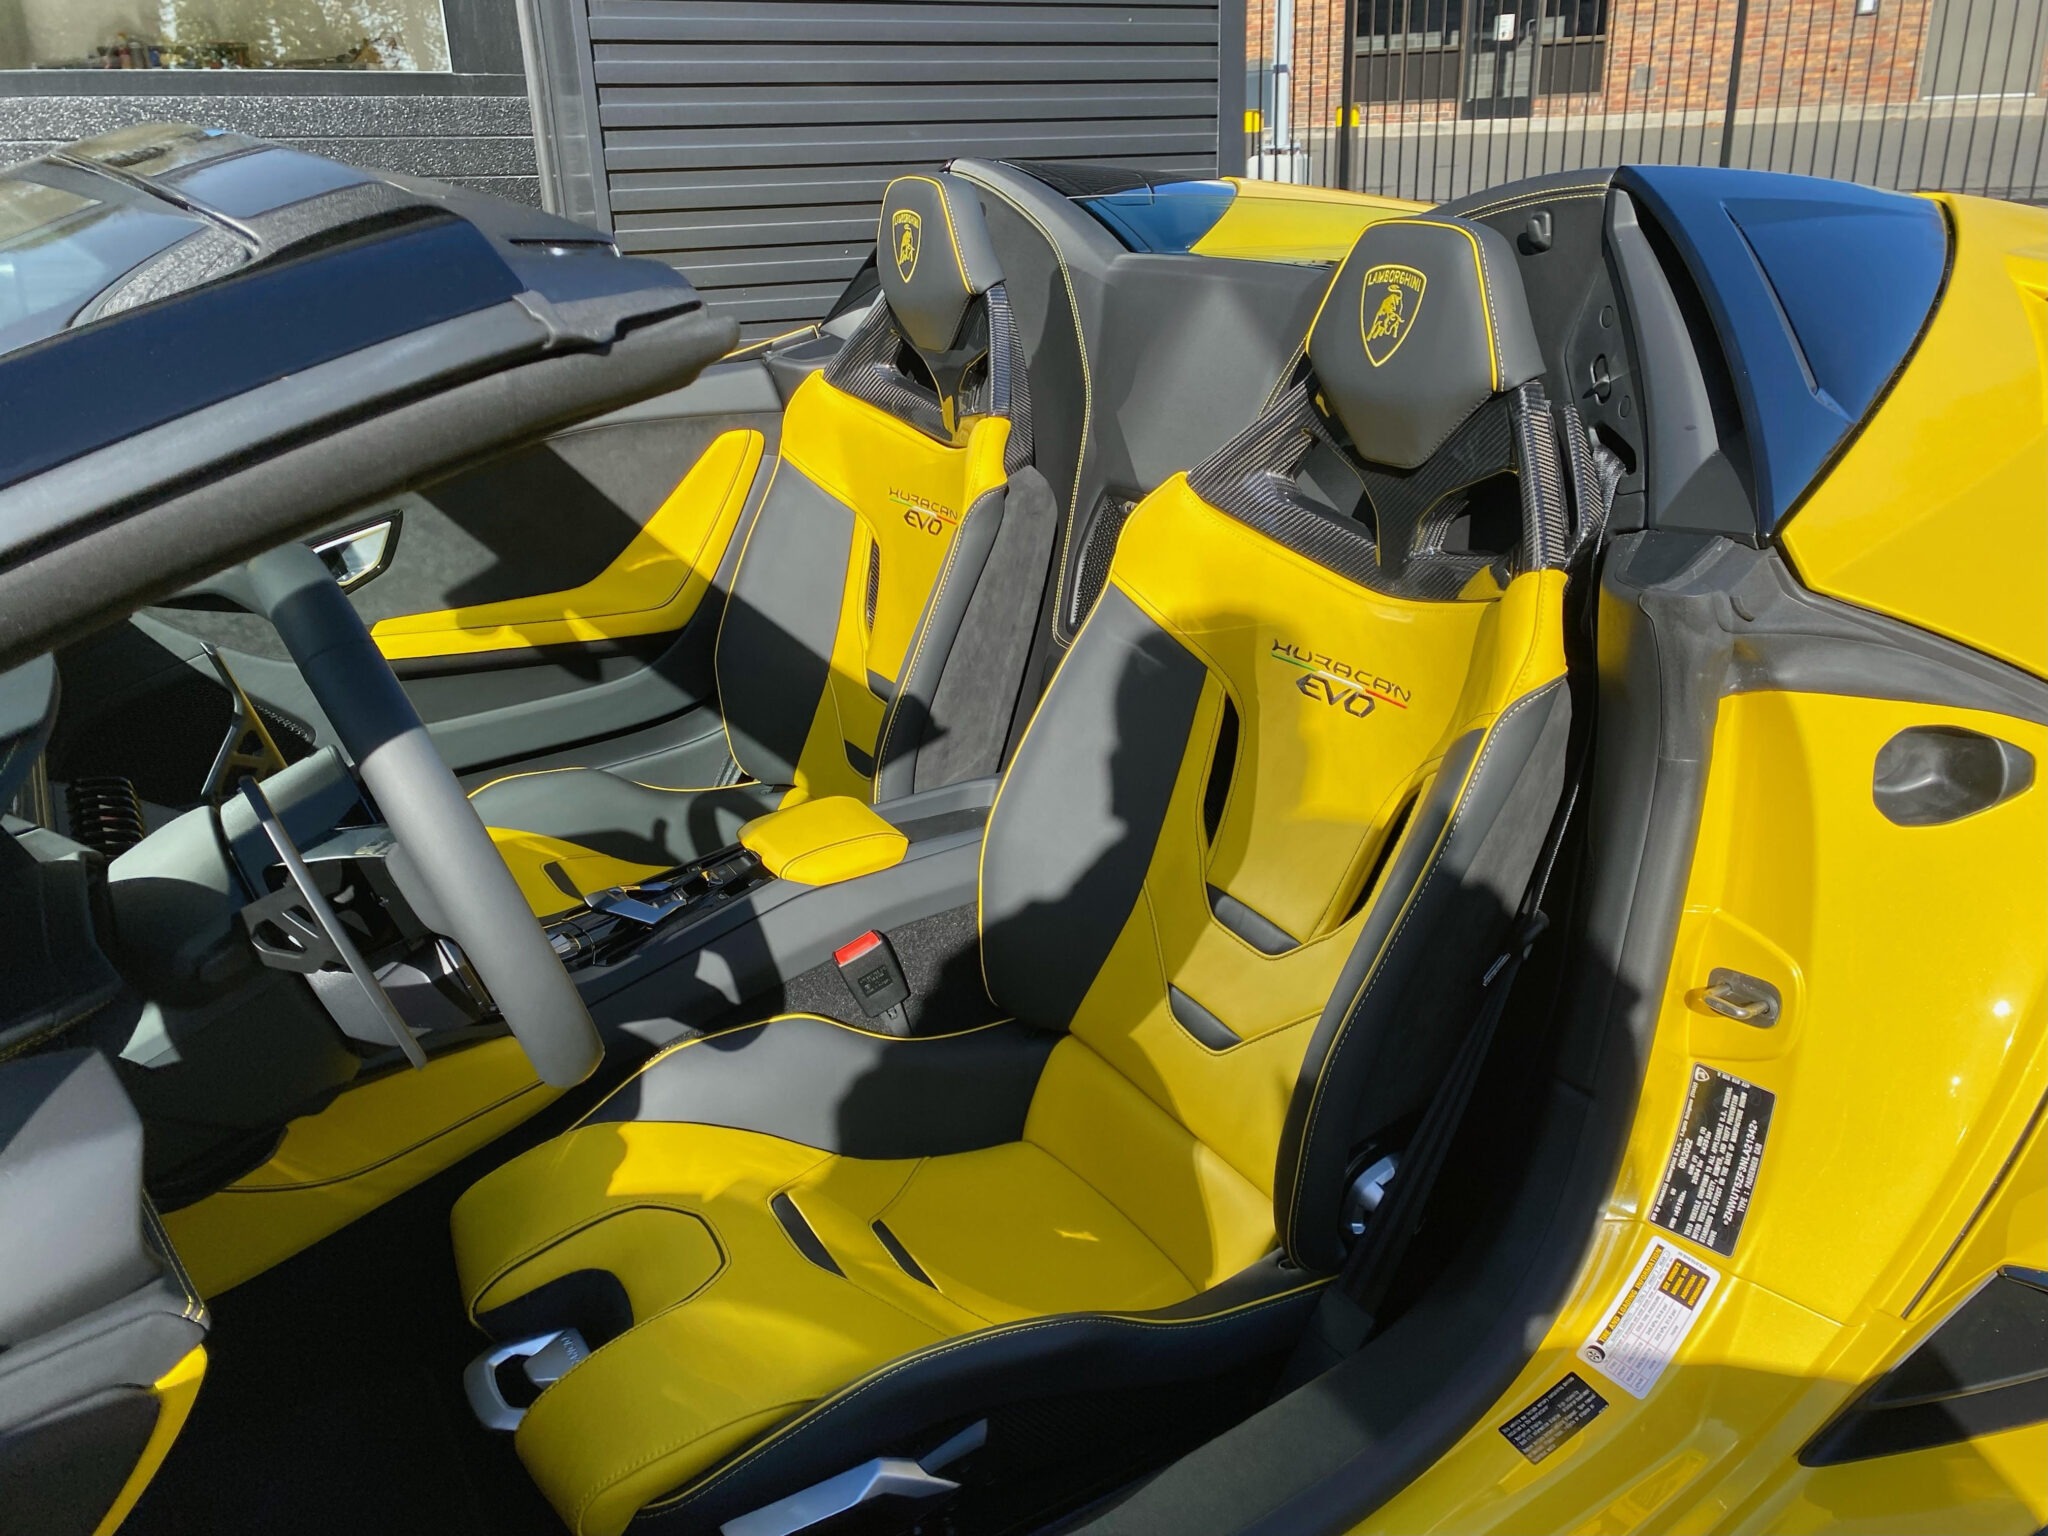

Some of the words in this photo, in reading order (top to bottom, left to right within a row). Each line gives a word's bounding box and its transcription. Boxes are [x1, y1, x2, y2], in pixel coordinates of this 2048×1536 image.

[1367, 269, 1423, 293] LAMBORGHINI
[903, 508, 943, 536] EVO
[1295, 672, 1376, 719] EVO
[1707, 1153, 1715, 1165] ALL
[1607, 1314, 1621, 1330] AND
[1617, 1288, 1638, 1316] LOADING
[1633, 1247, 1663, 1289] INFORMATION
